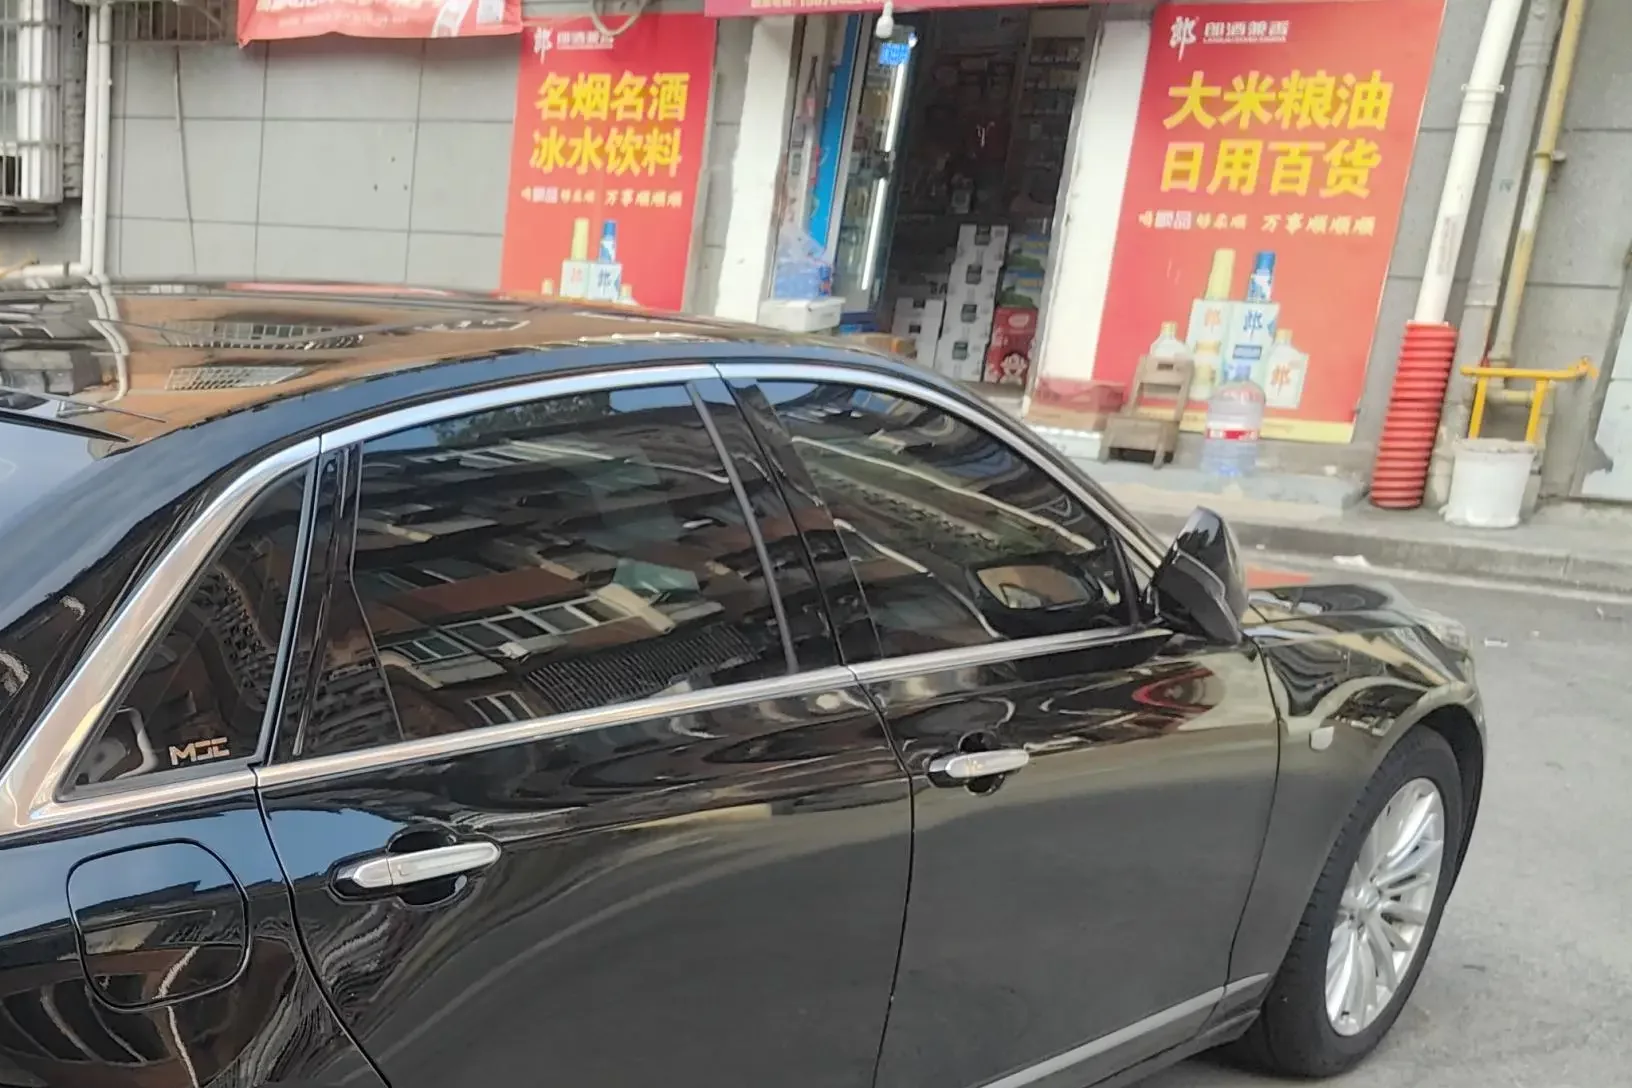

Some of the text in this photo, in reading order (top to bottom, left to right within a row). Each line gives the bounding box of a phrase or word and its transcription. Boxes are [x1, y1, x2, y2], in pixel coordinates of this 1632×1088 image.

[534, 71, 691, 122] 名烟名酒
[1162, 69, 1395, 131] 大米粮油
[529, 126, 682, 178] 冰水饮料
[1159, 138, 1382, 198] 日用百货
